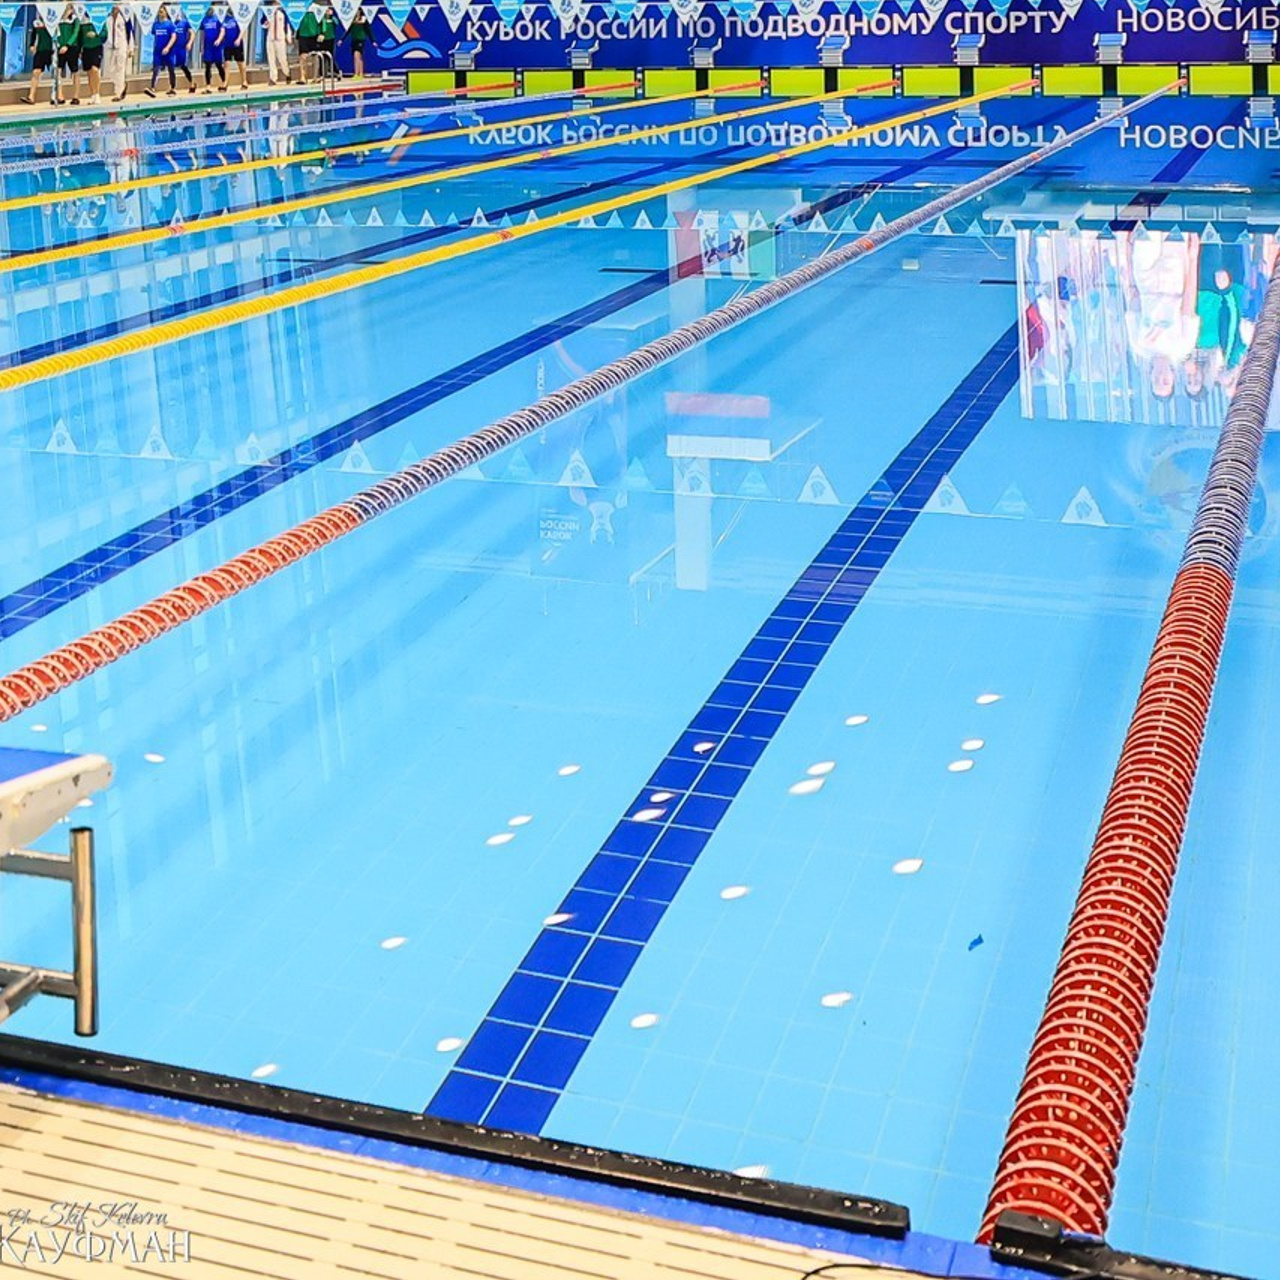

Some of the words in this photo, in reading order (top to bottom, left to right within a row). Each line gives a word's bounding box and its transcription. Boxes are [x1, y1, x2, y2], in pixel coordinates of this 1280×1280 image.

[466, 20, 552, 41] КУБОК
[561, 17, 667, 40] РОССИИ
[677, 16, 716, 39] ПО
[725, 12, 937, 40] ПОДВОДНОМУ
[945, 10, 1068, 35] СПОРТУ
[1117, 6, 1280, 33] НОВОСИБ
